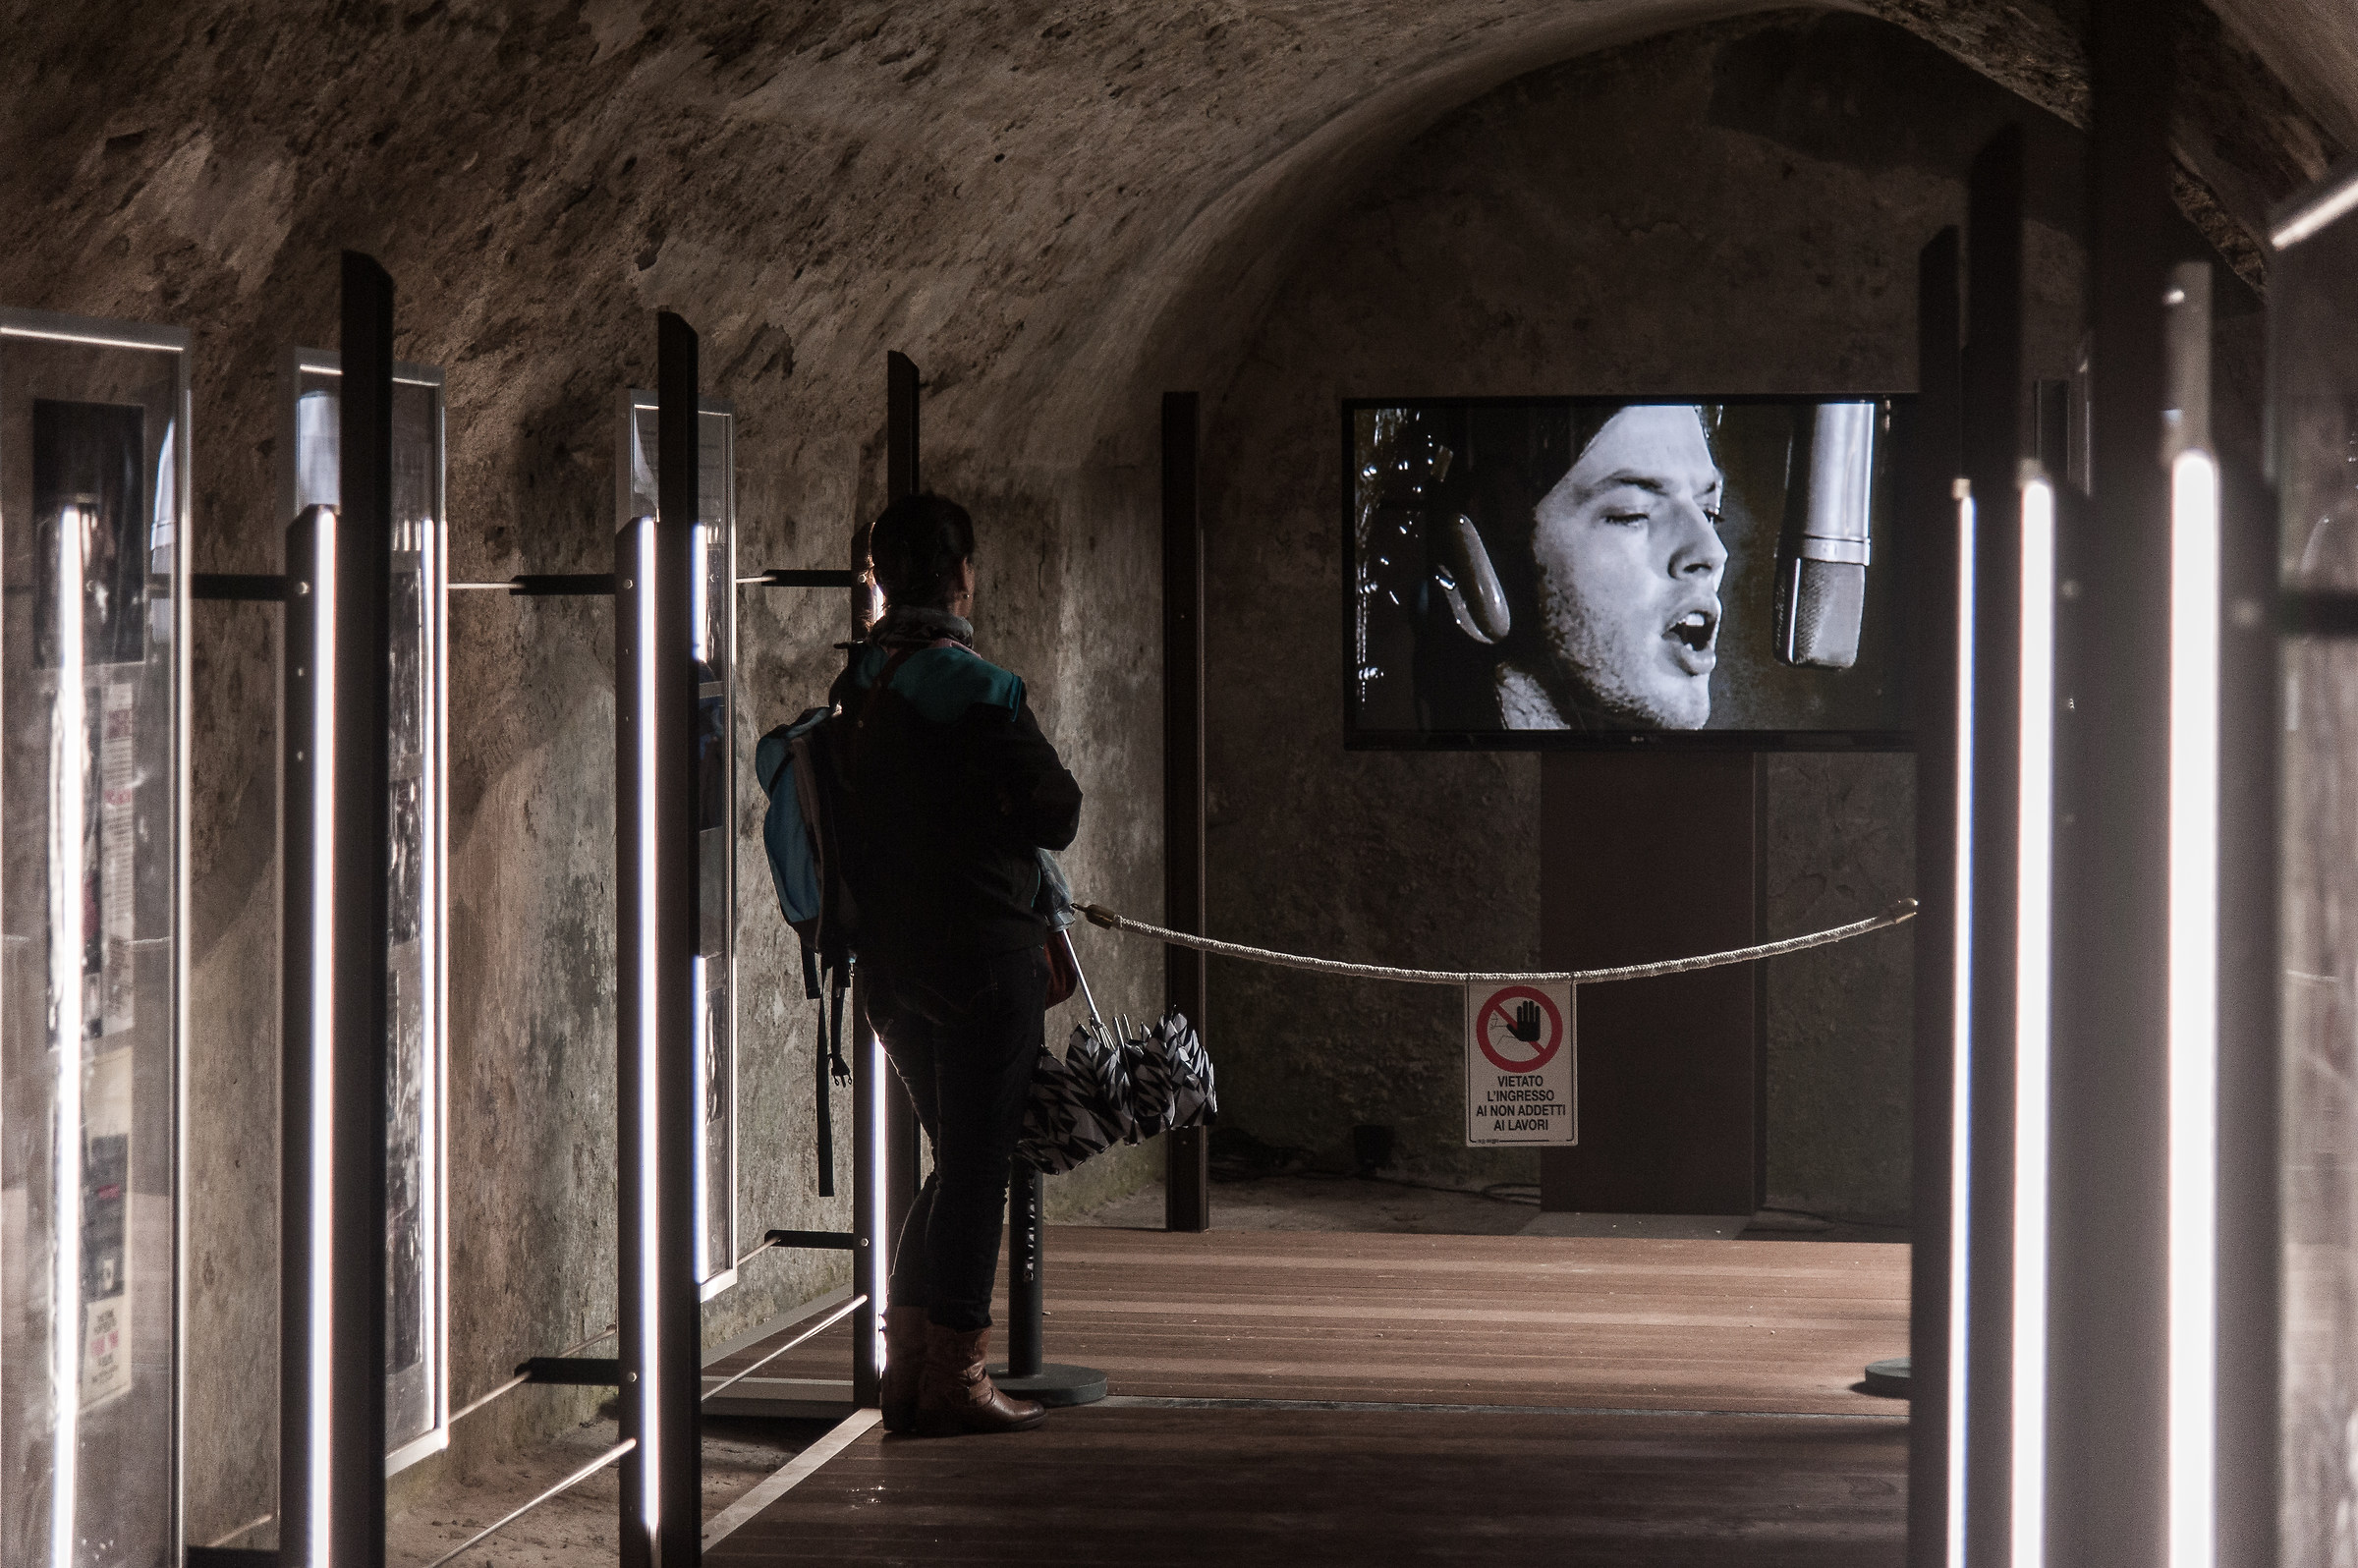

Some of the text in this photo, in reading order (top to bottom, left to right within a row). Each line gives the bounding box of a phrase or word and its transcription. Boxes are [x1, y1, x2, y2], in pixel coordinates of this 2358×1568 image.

[1497, 1075, 1544, 1088] VIETATO
[1488, 1090, 1554, 1102] L'INGRESSO
[1476, 1104, 1566, 1117] AI NON ADDETTI
[1493, 1119, 1548, 1131] AI LAVORI
